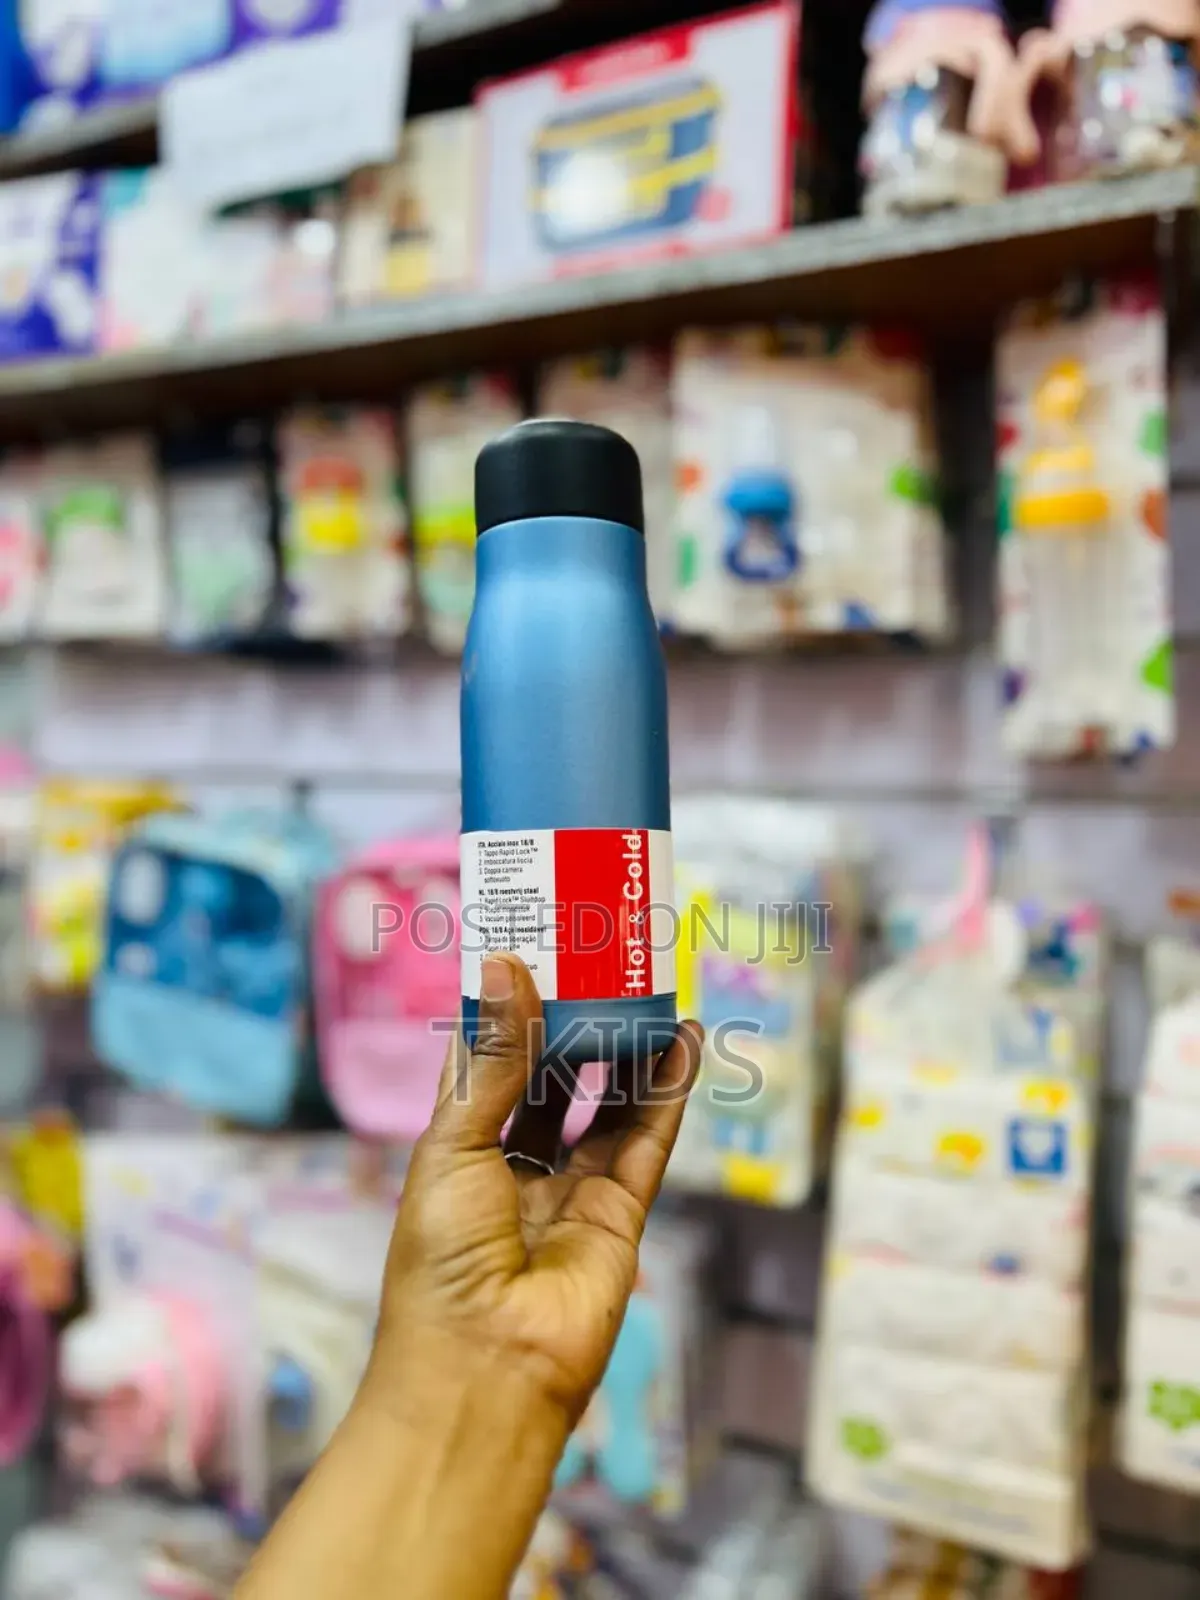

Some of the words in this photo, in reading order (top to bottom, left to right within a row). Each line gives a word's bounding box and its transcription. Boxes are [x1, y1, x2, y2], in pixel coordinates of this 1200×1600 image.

[499, 848, 515, 856] Rapid
[621, 834, 644, 900] Cold
[524, 886, 539, 895] staal
[629, 910, 645, 924] &
[625, 937, 646, 988] Hot
